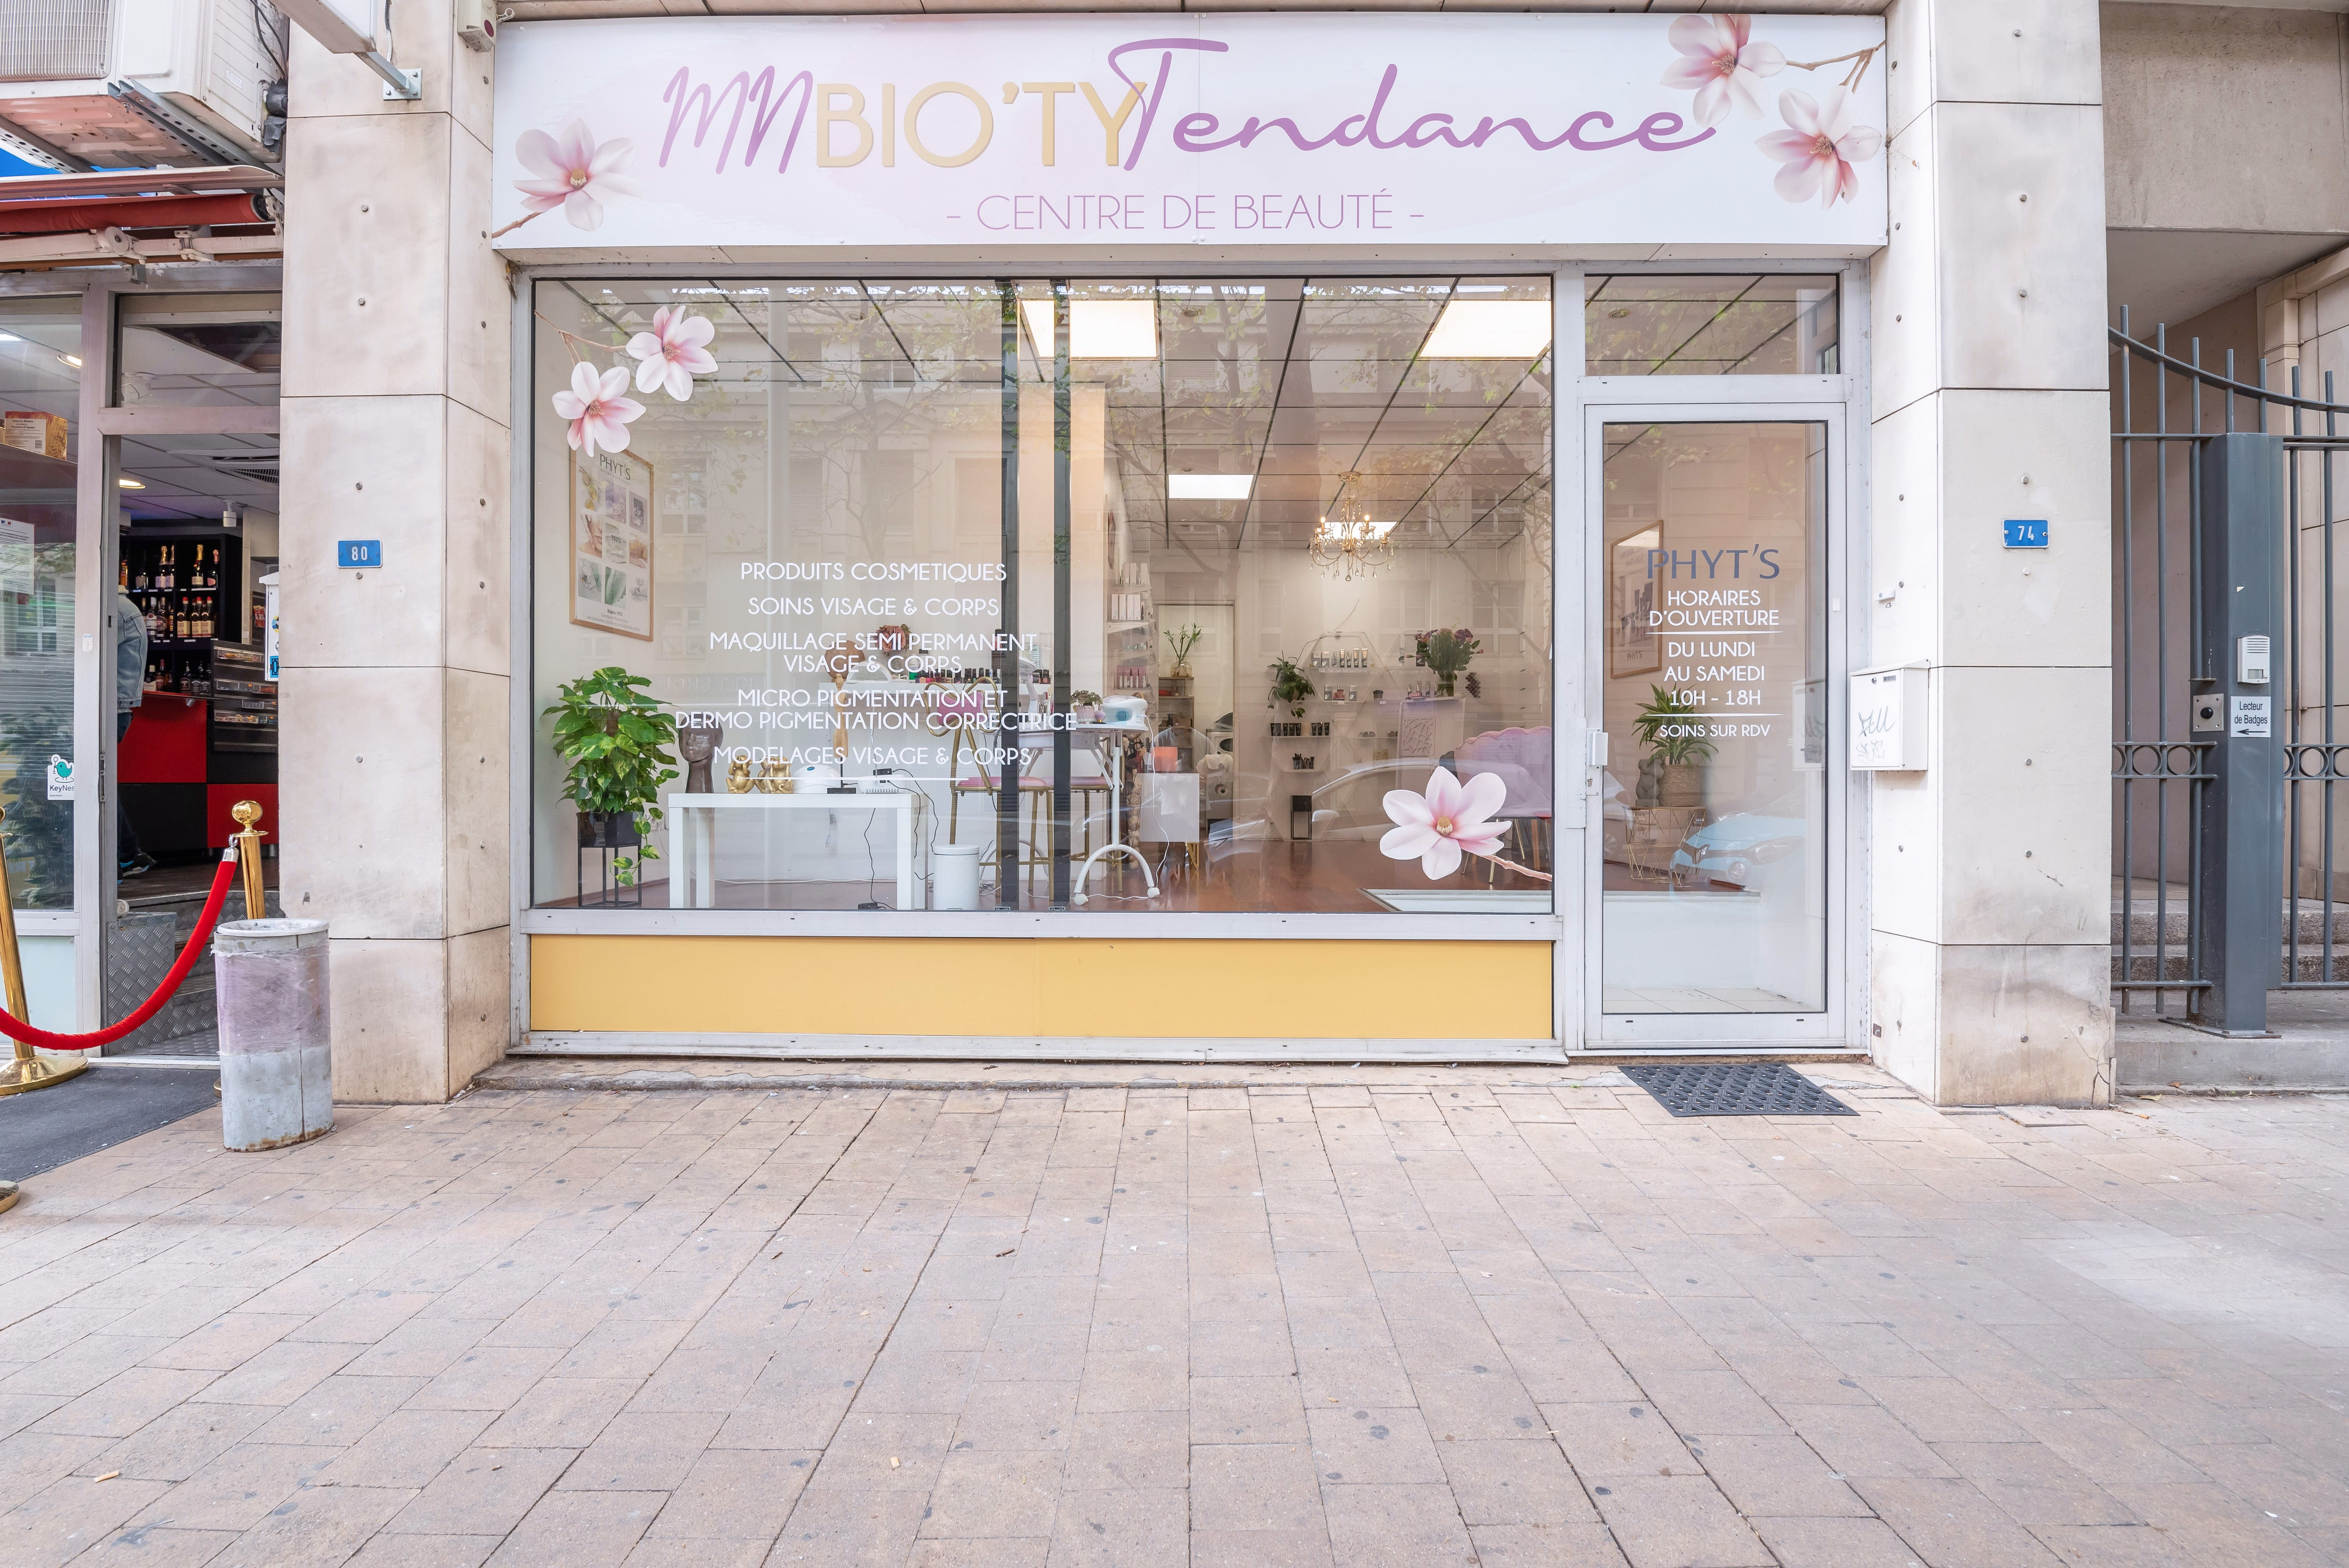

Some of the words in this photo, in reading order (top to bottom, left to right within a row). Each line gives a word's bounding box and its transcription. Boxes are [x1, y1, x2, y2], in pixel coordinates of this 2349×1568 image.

[1108, 38, 1717, 171] Tendance
[977, 195, 1144, 230] CENTRE
[1163, 195, 1215, 230] DE
[1235, 189, 1392, 230] BEAUTÉ
[600, 453, 631, 481] PHYT'S
[2018, 526, 2034, 541] 74
[351, 546, 367, 561] 80
[1647, 543, 1780, 580] PHYT'S
[741, 563, 844, 581] PRODUITS
[851, 563, 1007, 583] COSMETIQUES
[1668, 590, 1761, 606] HORAIRES
[748, 598, 815, 616] SOINS
[820, 598, 896, 616] VISAGE
[904, 598, 918, 616] &
[925, 598, 999, 616] CORPS
[1650, 609, 1779, 626] D'OUVERTURE
[710, 632, 847, 652] MAQUILLAGE
[854, 633, 901, 651] SEMI
[909, 633, 1037, 651] PERMANENT
[1668, 641, 1695, 657] DU
[1700, 641, 1755, 657] LUNDI
[784, 655, 859, 673] VISAGE
[866, 655, 880, 673] &
[888, 656, 962, 673] CORPS
[1627, 650, 1642, 661] PHYT'S
[1664, 665, 1692, 682] AU
[1696, 665, 1764, 682] SAMEDI
[738, 689, 810, 707] MICRO
[818, 690, 977, 707] PIGMENTATION
[984, 690, 1007, 708] ET
[1670, 690, 1705, 706] 10H
[1725, 690, 1761, 706] 18H
[2239, 701, 2263, 711] Lecteur
[675, 711, 753, 729] DERMO
[760, 712, 919, 729] PIGMENTATION
[926, 712, 1076, 731] CORRECTRICE
[2235, 715, 2242, 724] de
[2244, 715, 2267, 726] Badges
[1659, 724, 1705, 738] SOINS
[1709, 724, 1738, 738] SUR
[1741, 724, 1771, 738] RDV
[714, 746, 848, 765] MODELAGES
[853, 746, 929, 765] VISAGE
[935, 747, 950, 765] &
[957, 747, 1031, 766] CORPS
